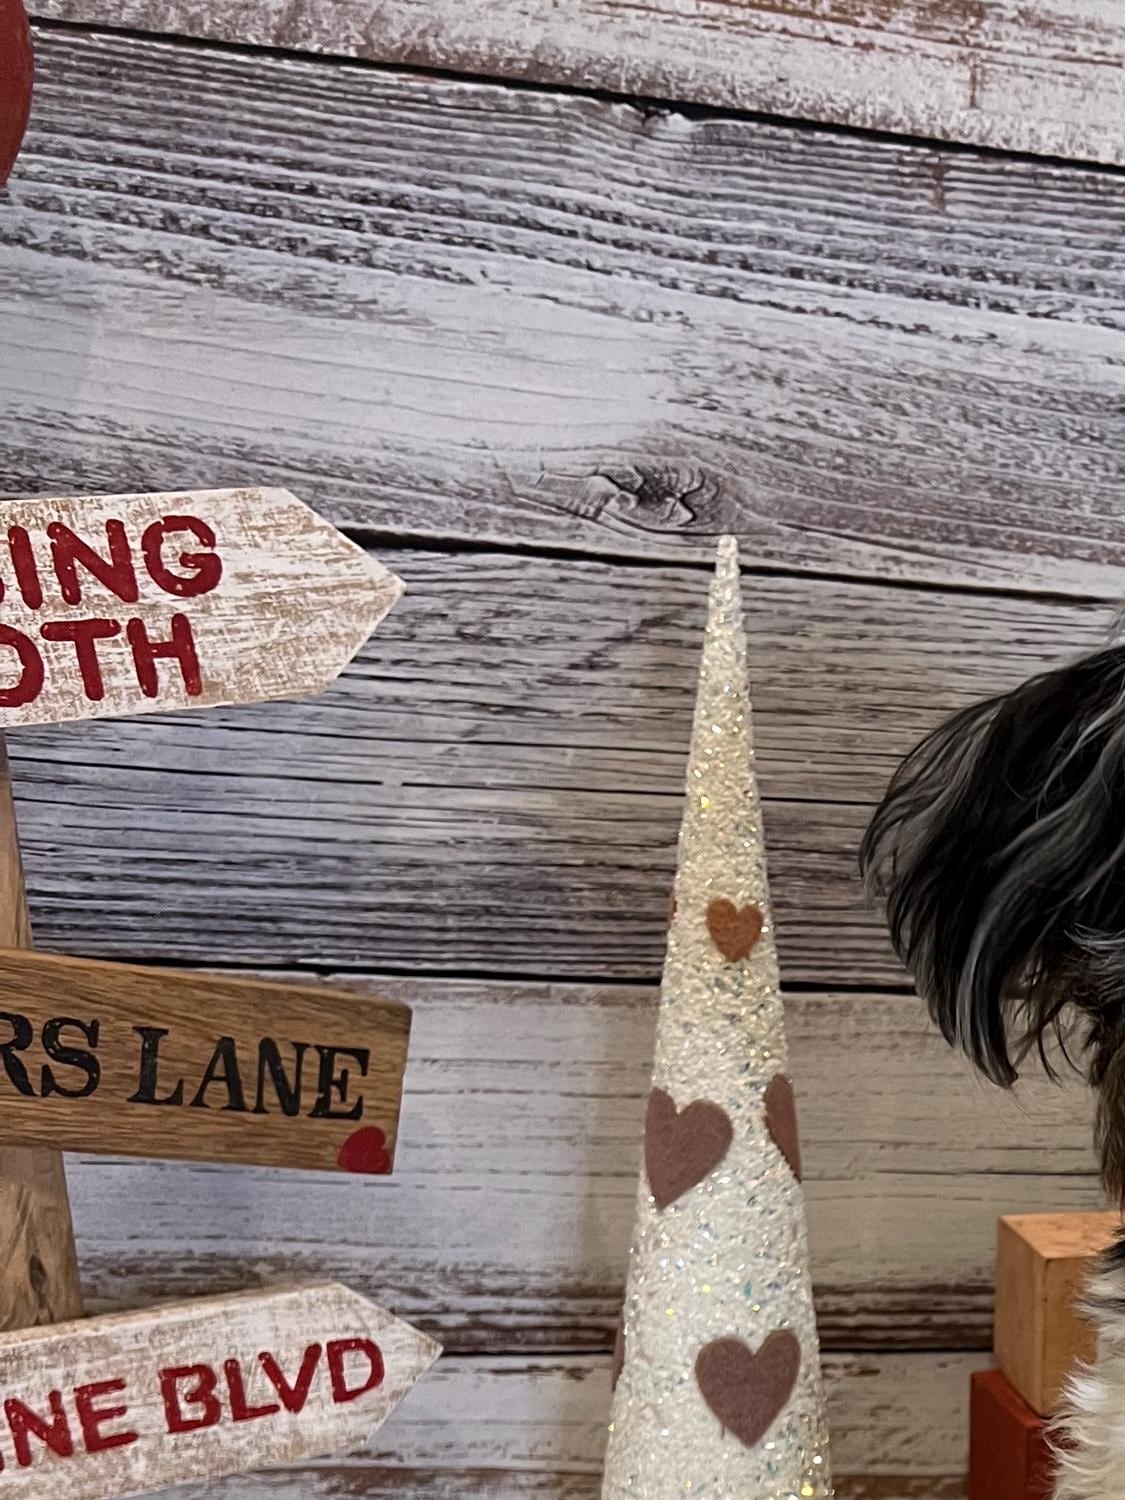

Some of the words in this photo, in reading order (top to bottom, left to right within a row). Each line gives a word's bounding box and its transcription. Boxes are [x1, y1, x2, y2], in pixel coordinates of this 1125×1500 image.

[0, 515, 223, 610] ING
[127, 1025, 370, 1120] LANE
[0, 1378, 138, 1470] NE
[159, 1338, 385, 1434] BLVD
